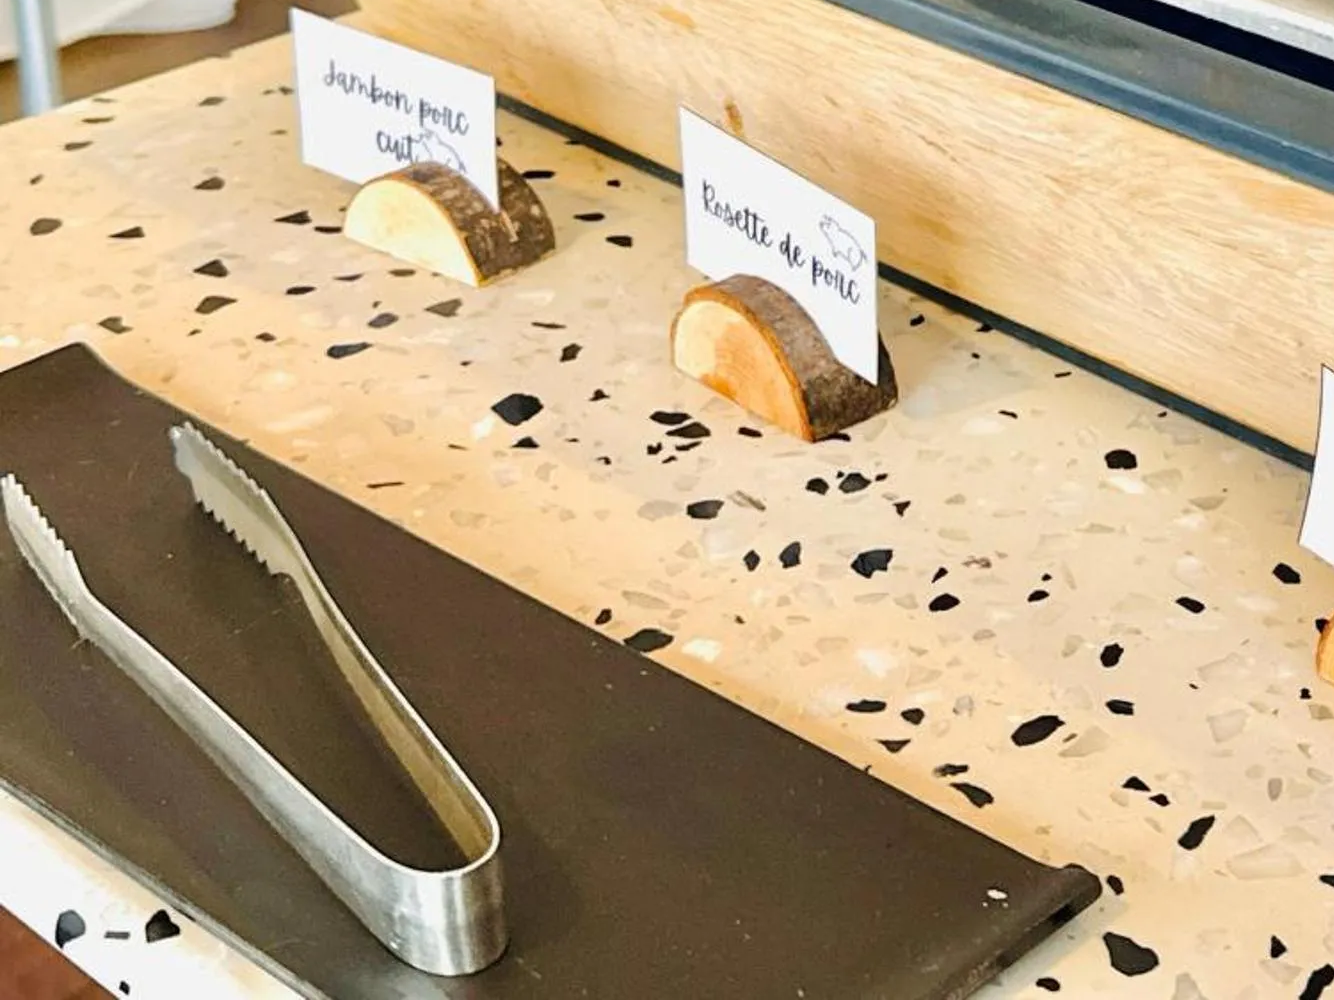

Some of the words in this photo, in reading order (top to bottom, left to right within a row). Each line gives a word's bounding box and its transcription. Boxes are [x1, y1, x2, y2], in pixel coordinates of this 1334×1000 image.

[323, 59, 413, 115] Jambon
[419, 98, 469, 135] porc
[702, 180, 773, 248] Rosette
[779, 232, 806, 268] de
[812, 256, 860, 304] porc
